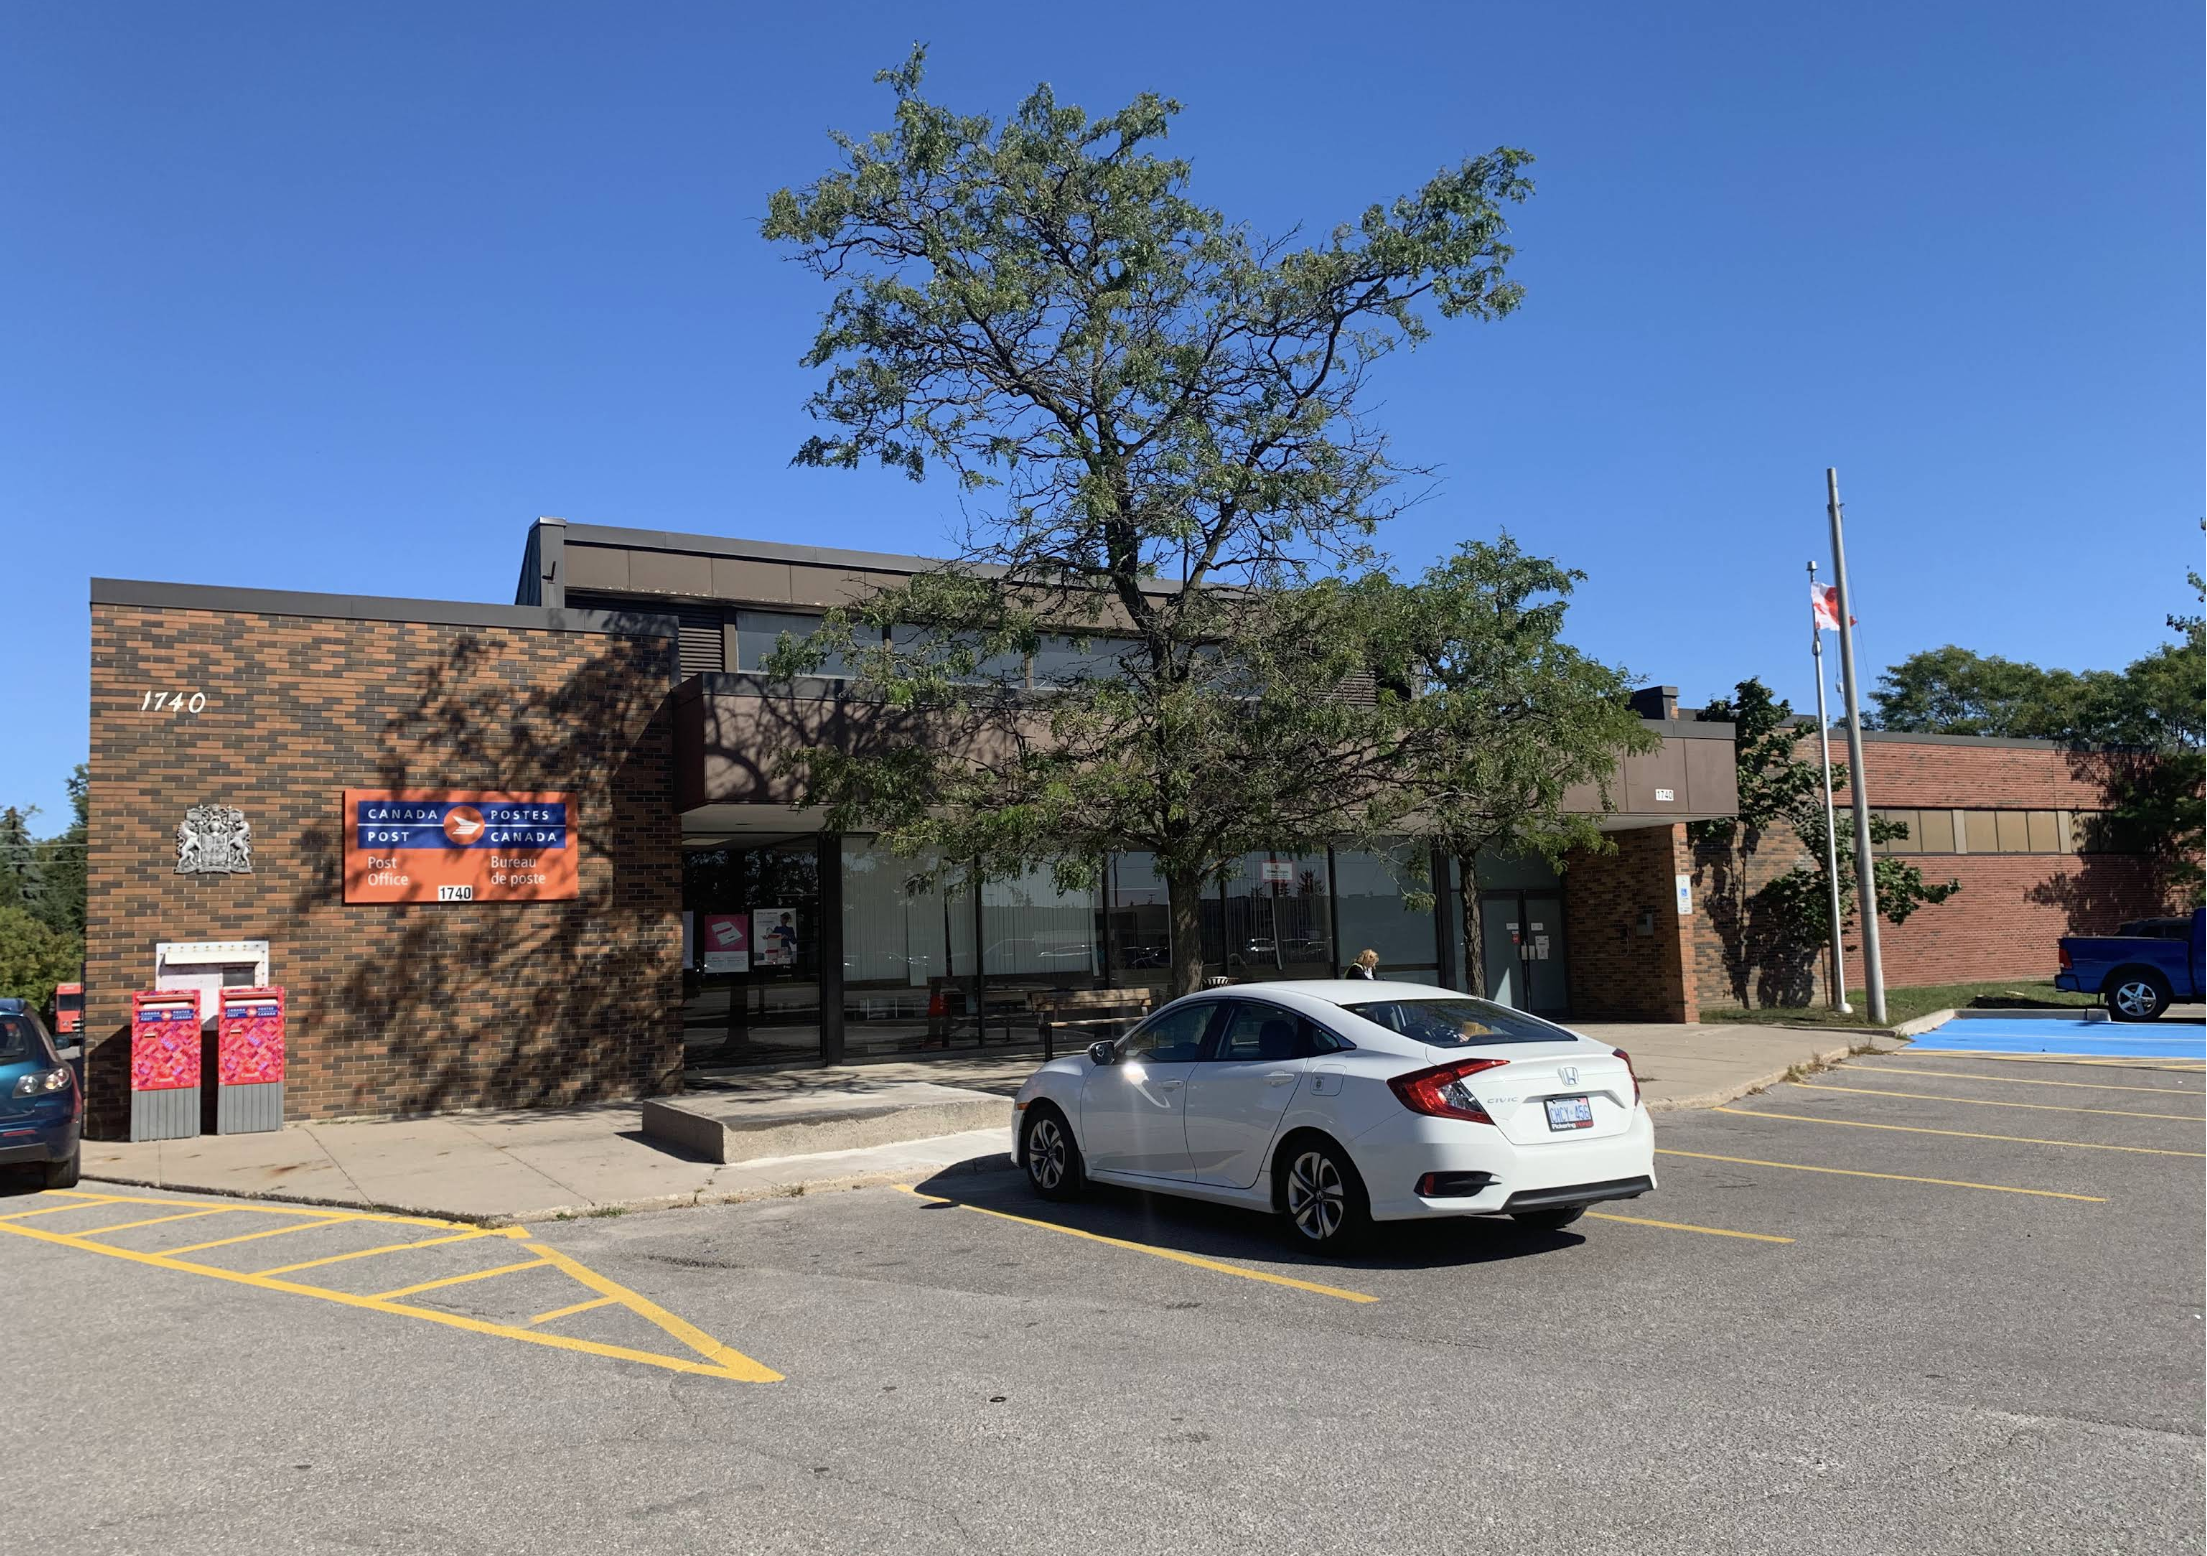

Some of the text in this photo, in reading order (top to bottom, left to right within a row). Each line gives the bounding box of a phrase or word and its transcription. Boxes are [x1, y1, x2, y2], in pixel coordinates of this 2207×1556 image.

[141, 690, 206, 714] 1740
[1657, 790, 1673, 800] 1740
[368, 808, 438, 820] CANADA
[490, 810, 550, 821] POSTES
[368, 831, 410, 842] POST
[490, 831, 557, 842] CANADA
[367, 856, 397, 869] Post
[490, 855, 537, 868] Bureau
[367, 873, 409, 886] Office
[490, 872, 546, 887] de poste
[439, 887, 471, 900] 1740
[1487, 1096, 1519, 1104] CIVIC
